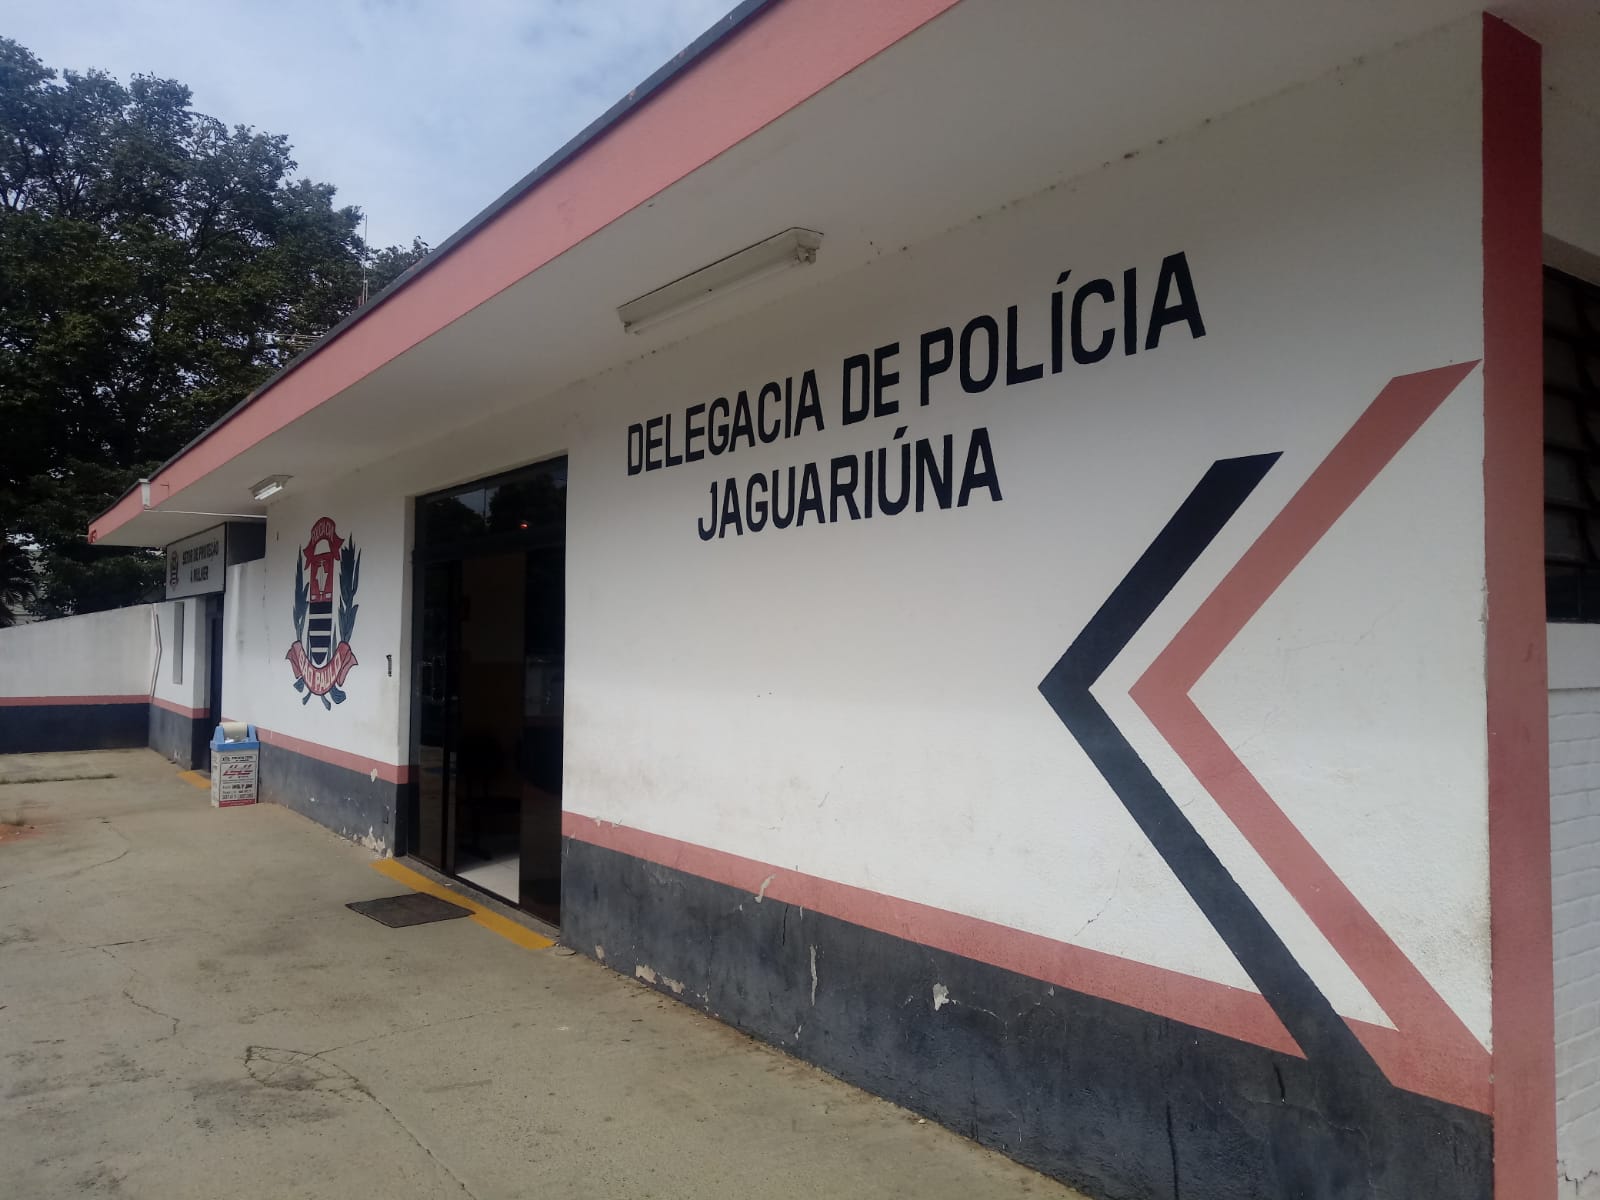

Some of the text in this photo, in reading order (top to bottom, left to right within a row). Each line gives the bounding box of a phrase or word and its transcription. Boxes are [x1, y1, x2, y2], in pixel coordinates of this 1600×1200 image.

[627, 250, 1207, 477] DELEGACIA DE POLÍCIA
[697, 426, 1003, 542] JAGUARIÚNA
[314, 651, 342, 692] PAULO
